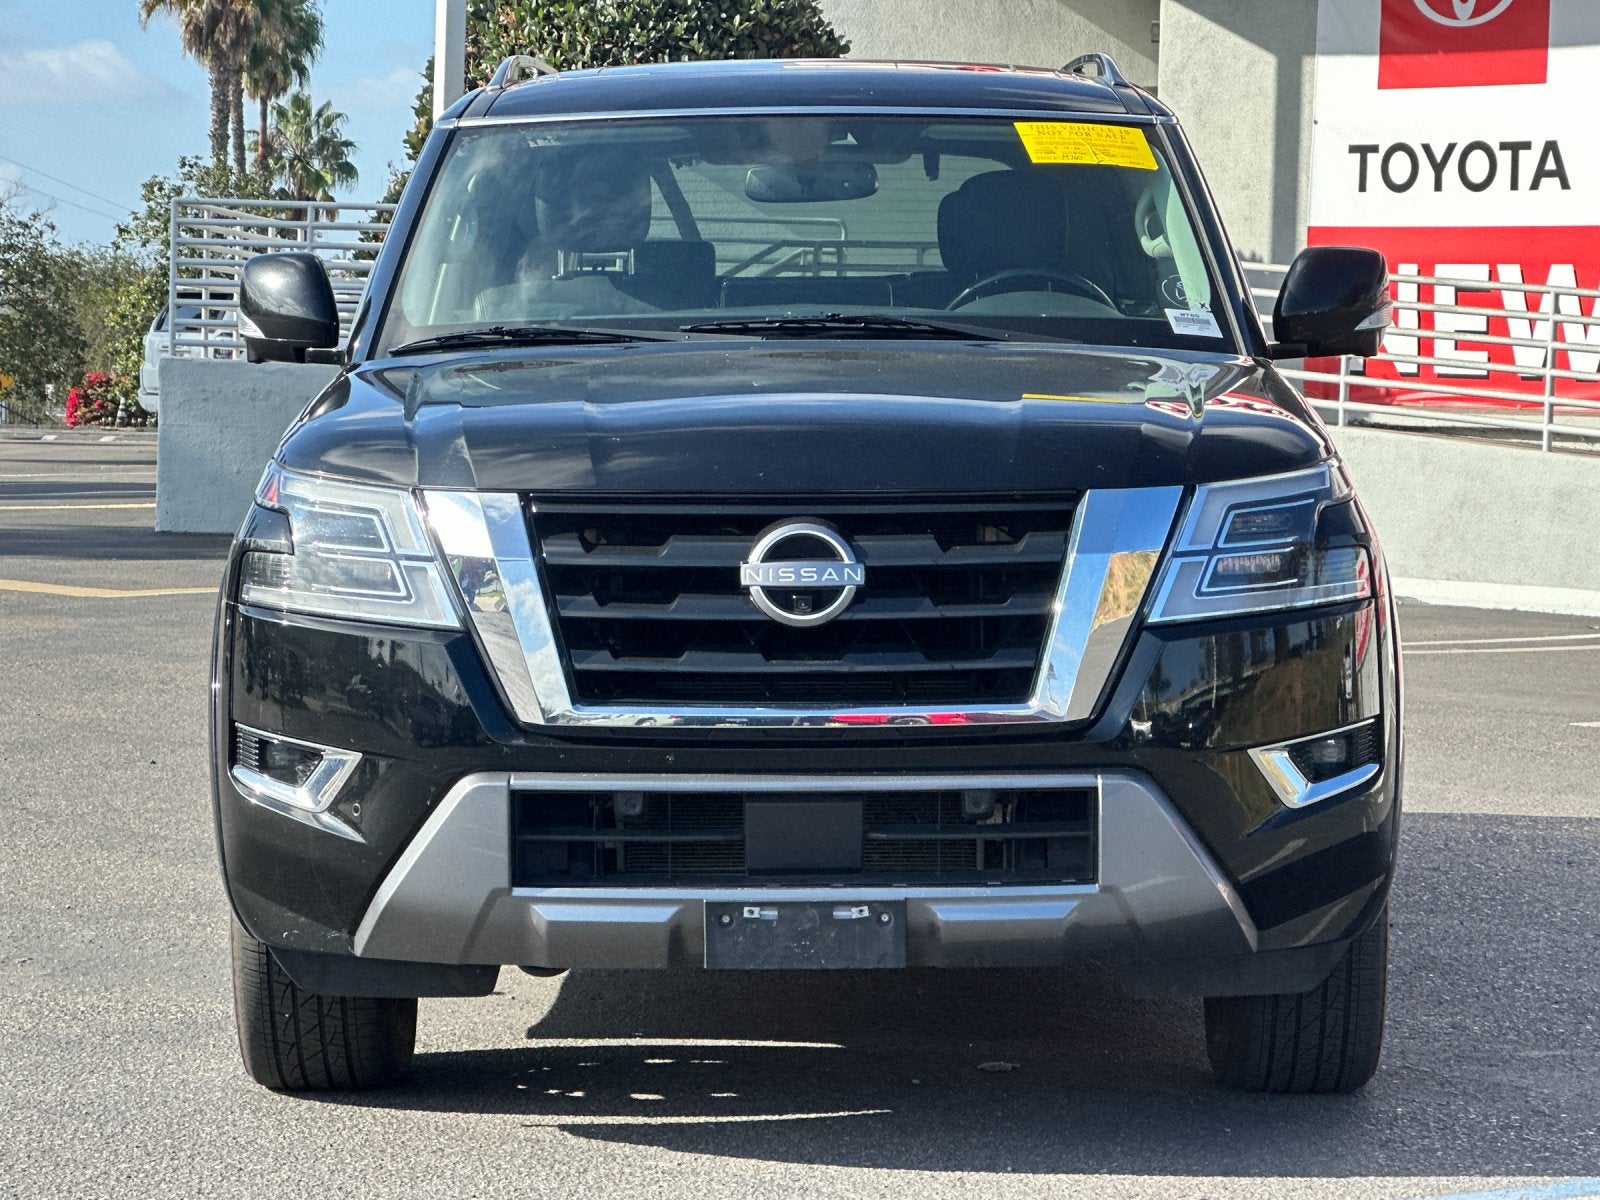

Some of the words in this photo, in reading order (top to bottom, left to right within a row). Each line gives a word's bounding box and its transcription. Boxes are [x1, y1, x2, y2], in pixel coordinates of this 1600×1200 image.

[1096, 132, 1127, 140] SALE
[1348, 140, 1571, 193] TOYOTA
[745, 567, 861, 582] NISSAN
